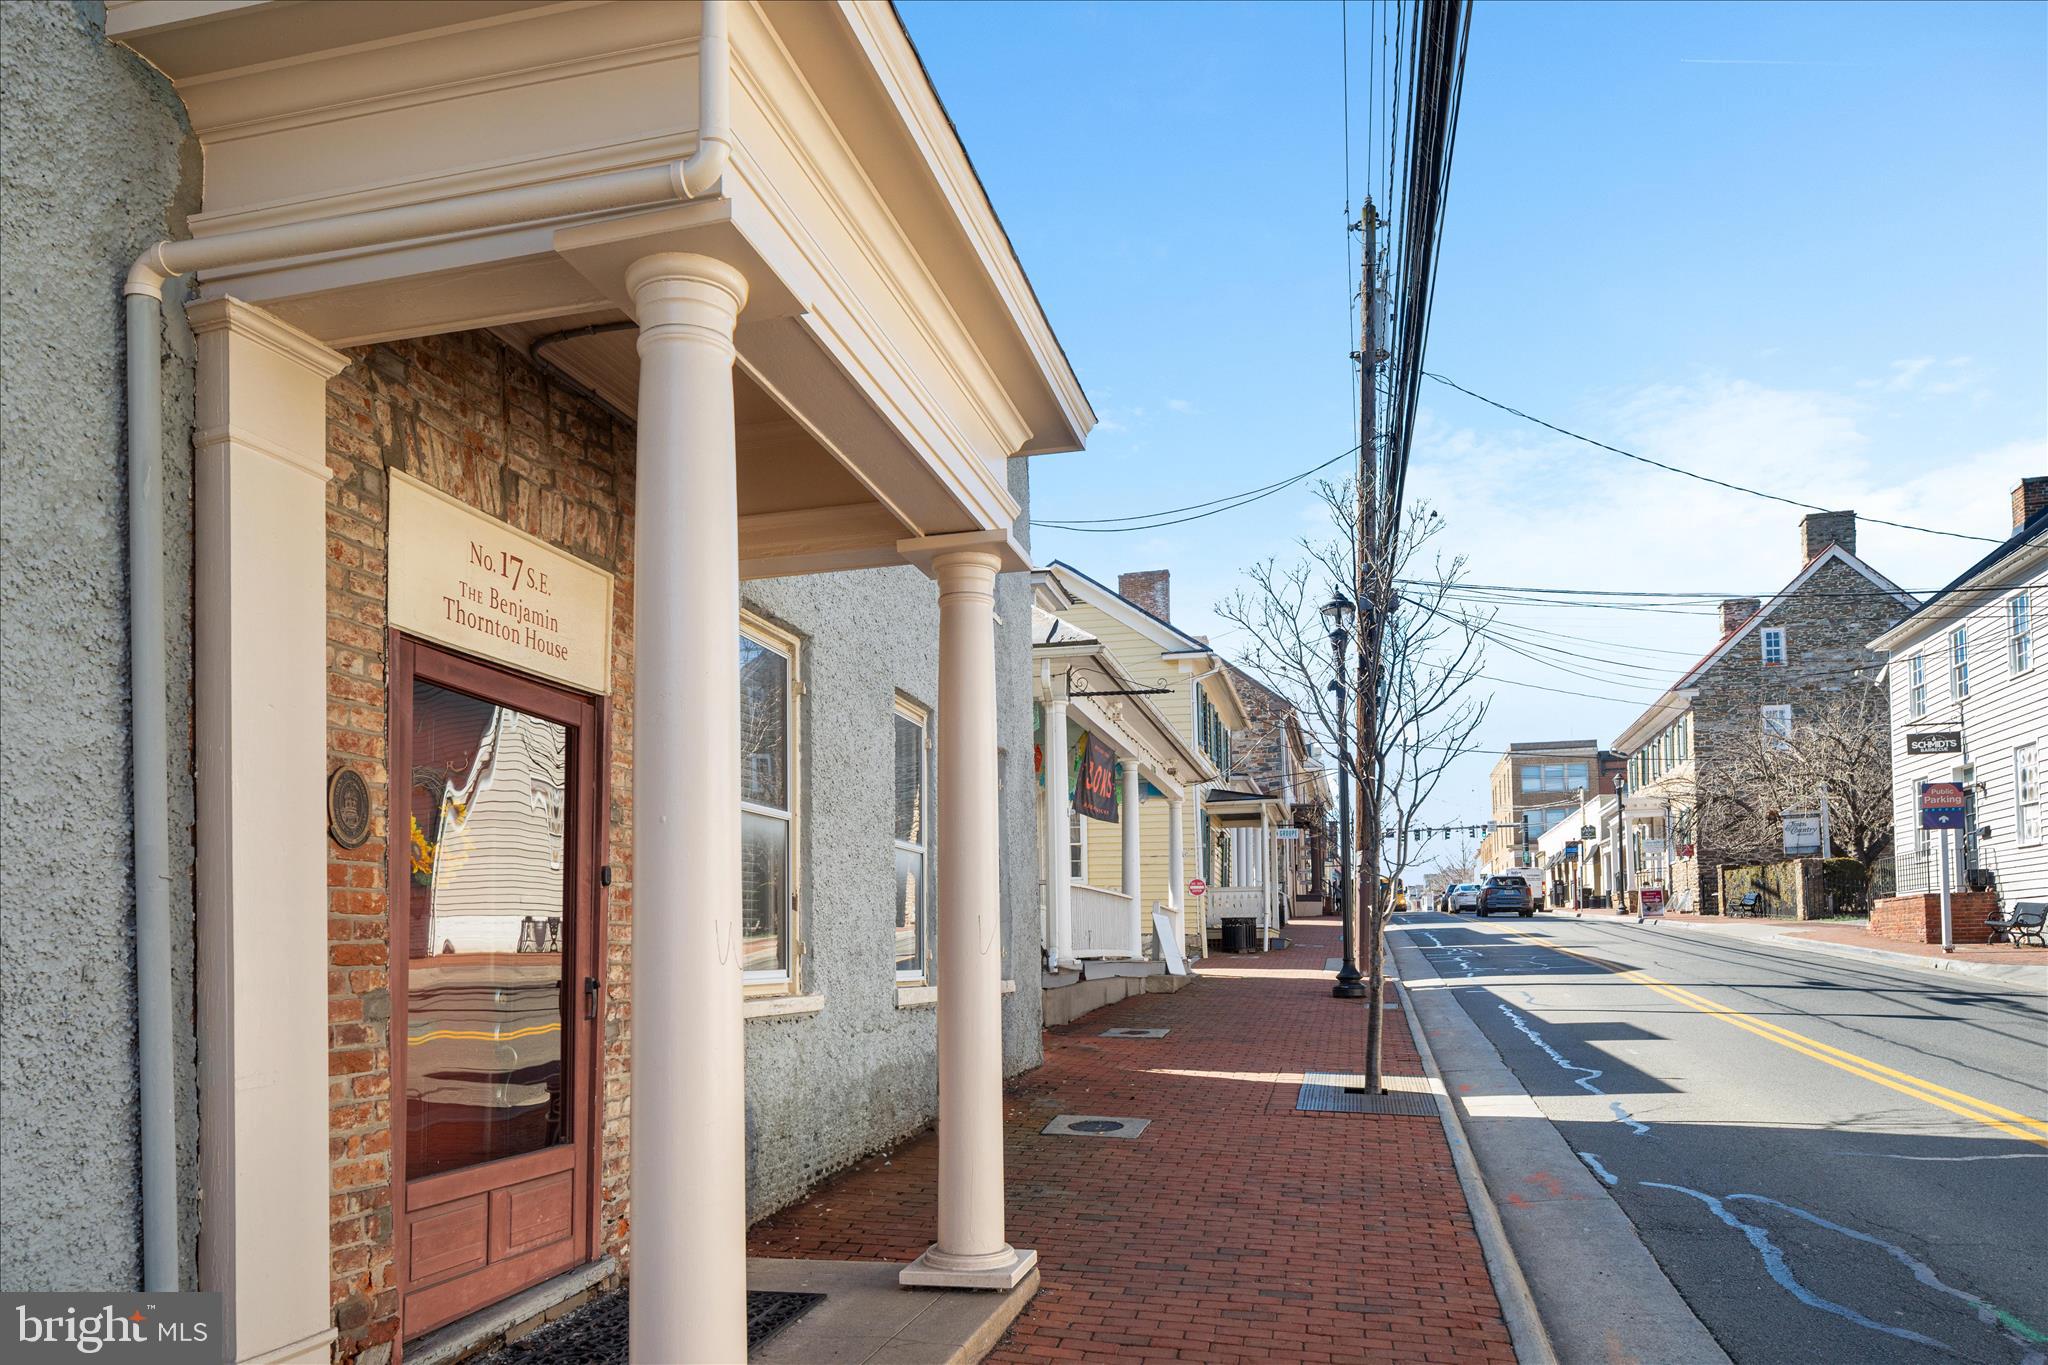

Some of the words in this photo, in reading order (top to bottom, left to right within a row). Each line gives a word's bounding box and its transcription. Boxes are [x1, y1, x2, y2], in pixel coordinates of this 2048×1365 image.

[527, 567, 552, 596] S.E.
[459, 581, 484, 604] THE
[489, 587, 558, 633] Benjamin
[443, 596, 521, 645] Thornton
[525, 627, 569, 661] House
[1924, 795, 1962, 804] Parking
